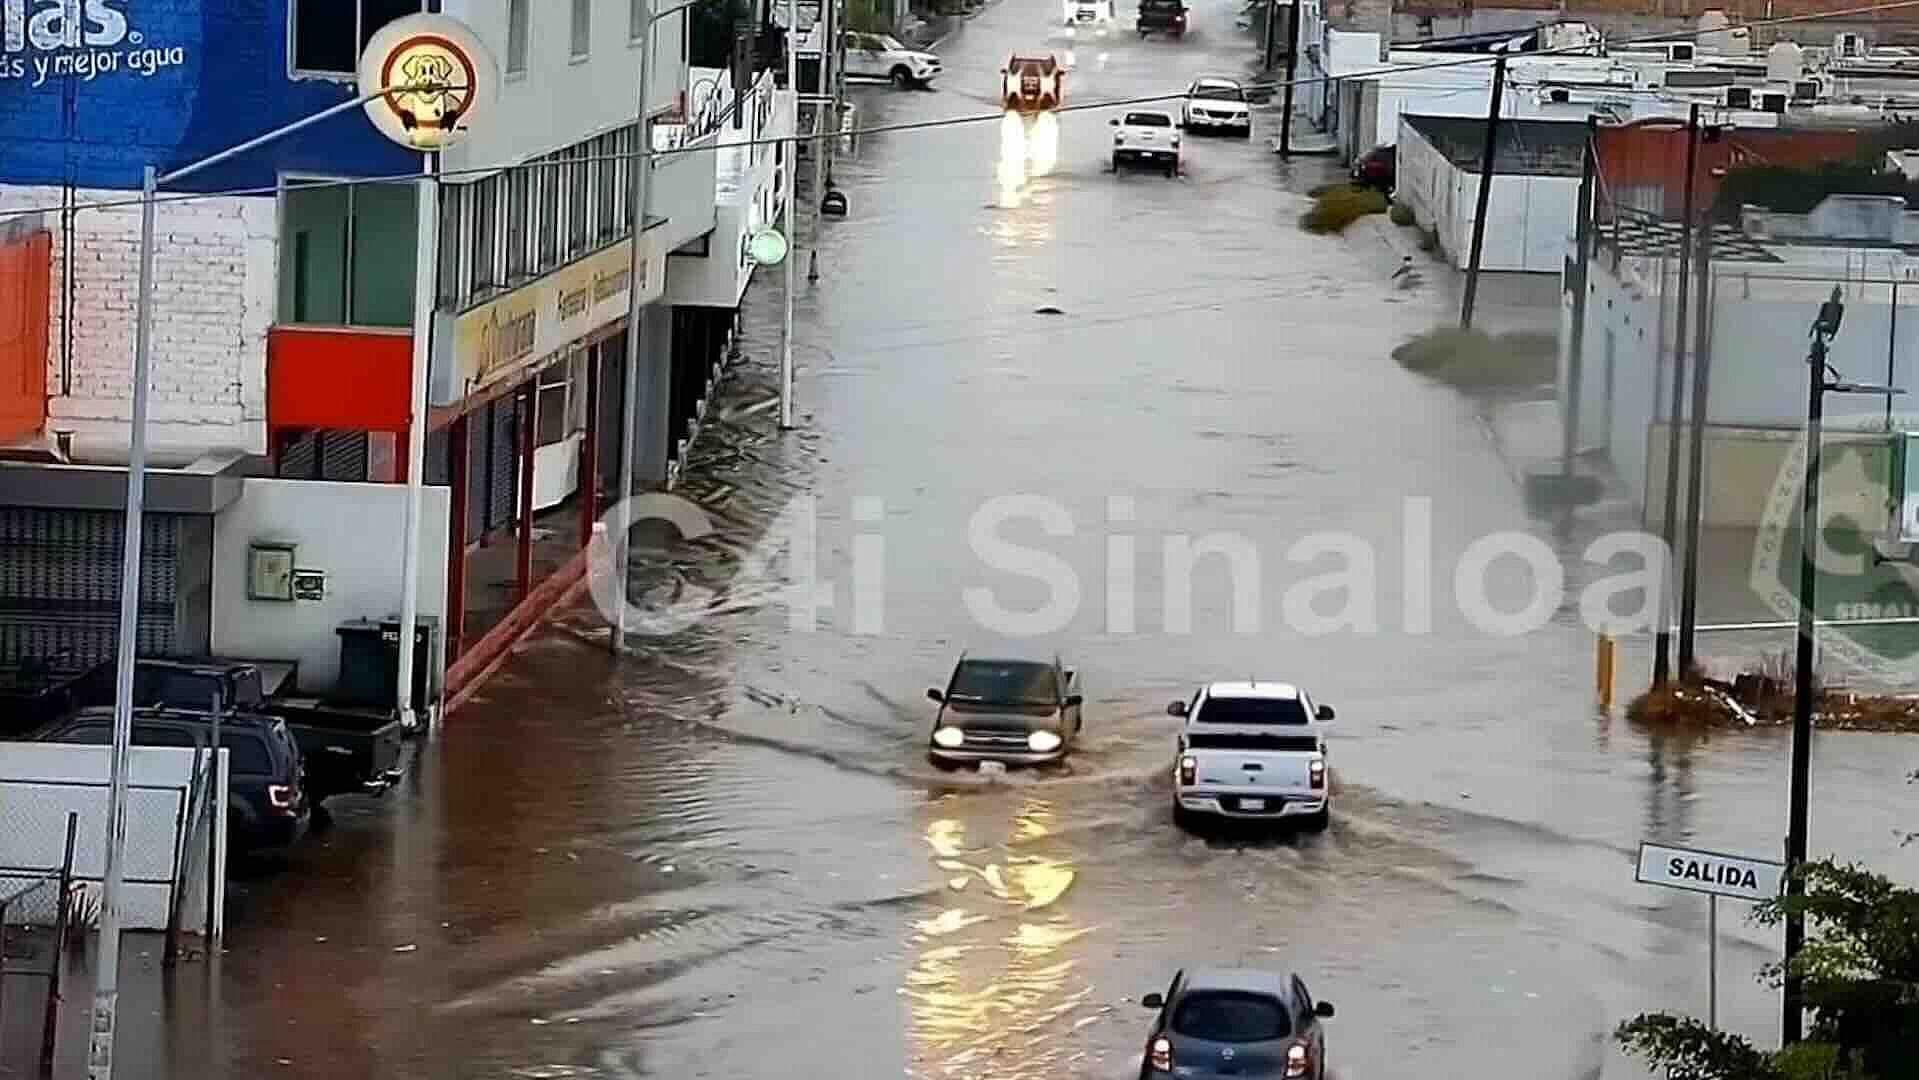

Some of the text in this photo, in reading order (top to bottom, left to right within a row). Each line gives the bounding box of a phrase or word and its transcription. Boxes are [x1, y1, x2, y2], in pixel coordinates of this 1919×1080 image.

[32, 57, 48, 87] y
[55, 49, 122, 80] mejor
[128, 47, 184, 76] agua
[1668, 857, 1758, 889] SALIDA
